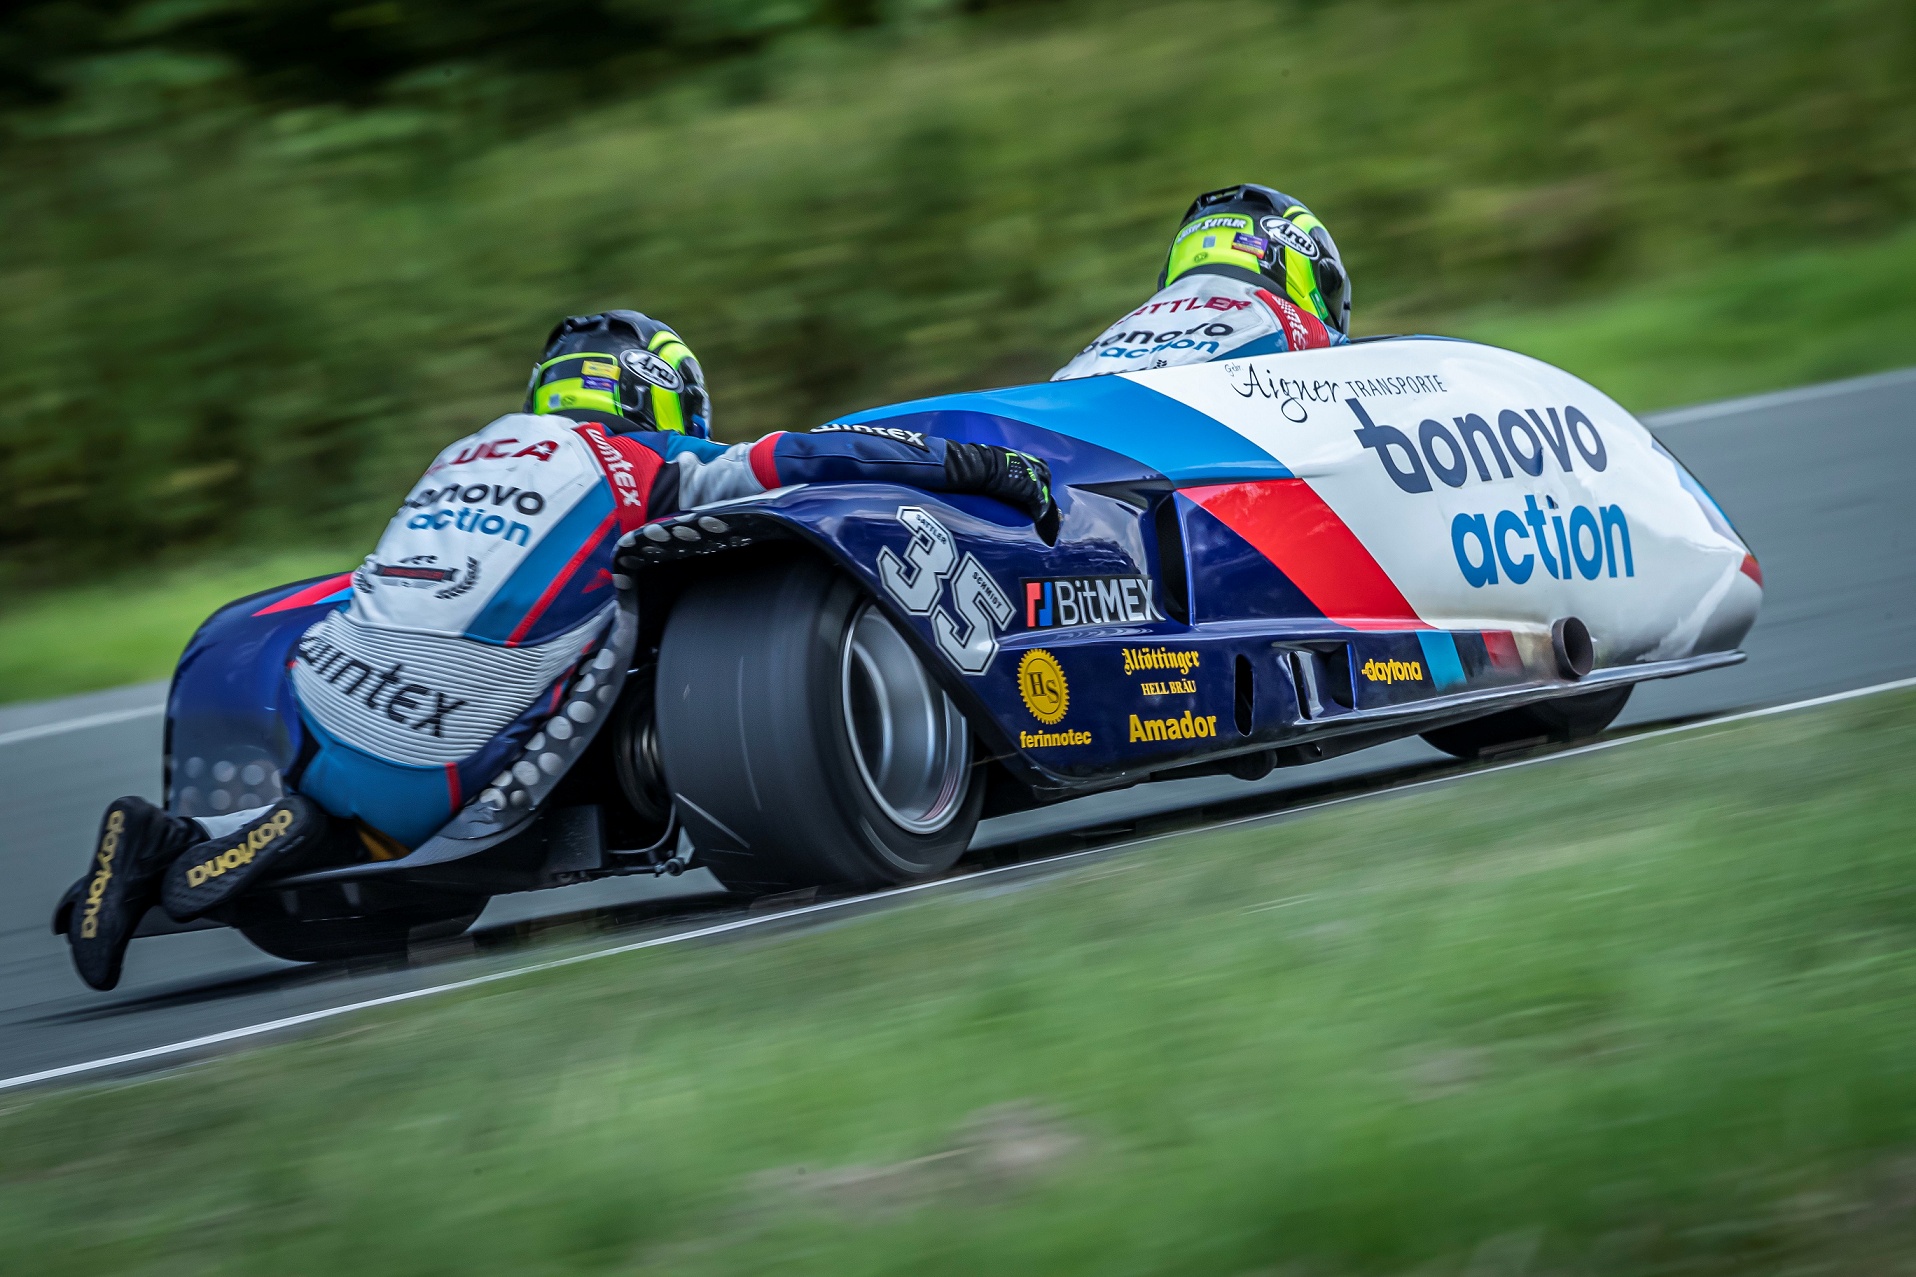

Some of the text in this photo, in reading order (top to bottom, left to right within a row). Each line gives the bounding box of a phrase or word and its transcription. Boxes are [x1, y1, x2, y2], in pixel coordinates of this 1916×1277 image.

[1231, 363, 1340, 423] Aigner
[1345, 375, 1447, 398] TRANSPORTE
[1345, 397, 1608, 494] bonovo
[407, 507, 532, 547] action
[916, 514, 948, 545] SATTLER
[1450, 494, 1635, 588] action
[876, 506, 1017, 676] 35
[972, 571, 1003, 609] SCHMIDT
[1055, 578, 1167, 626] BitMEX
[1122, 646, 1200, 675] Altöttinger
[1363, 658, 1423, 684] daytona
[1140, 678, 1196, 695] HELL BRÄU
[1020, 729, 1092, 748] ferinnotec
[1129, 710, 1217, 743] Amador
